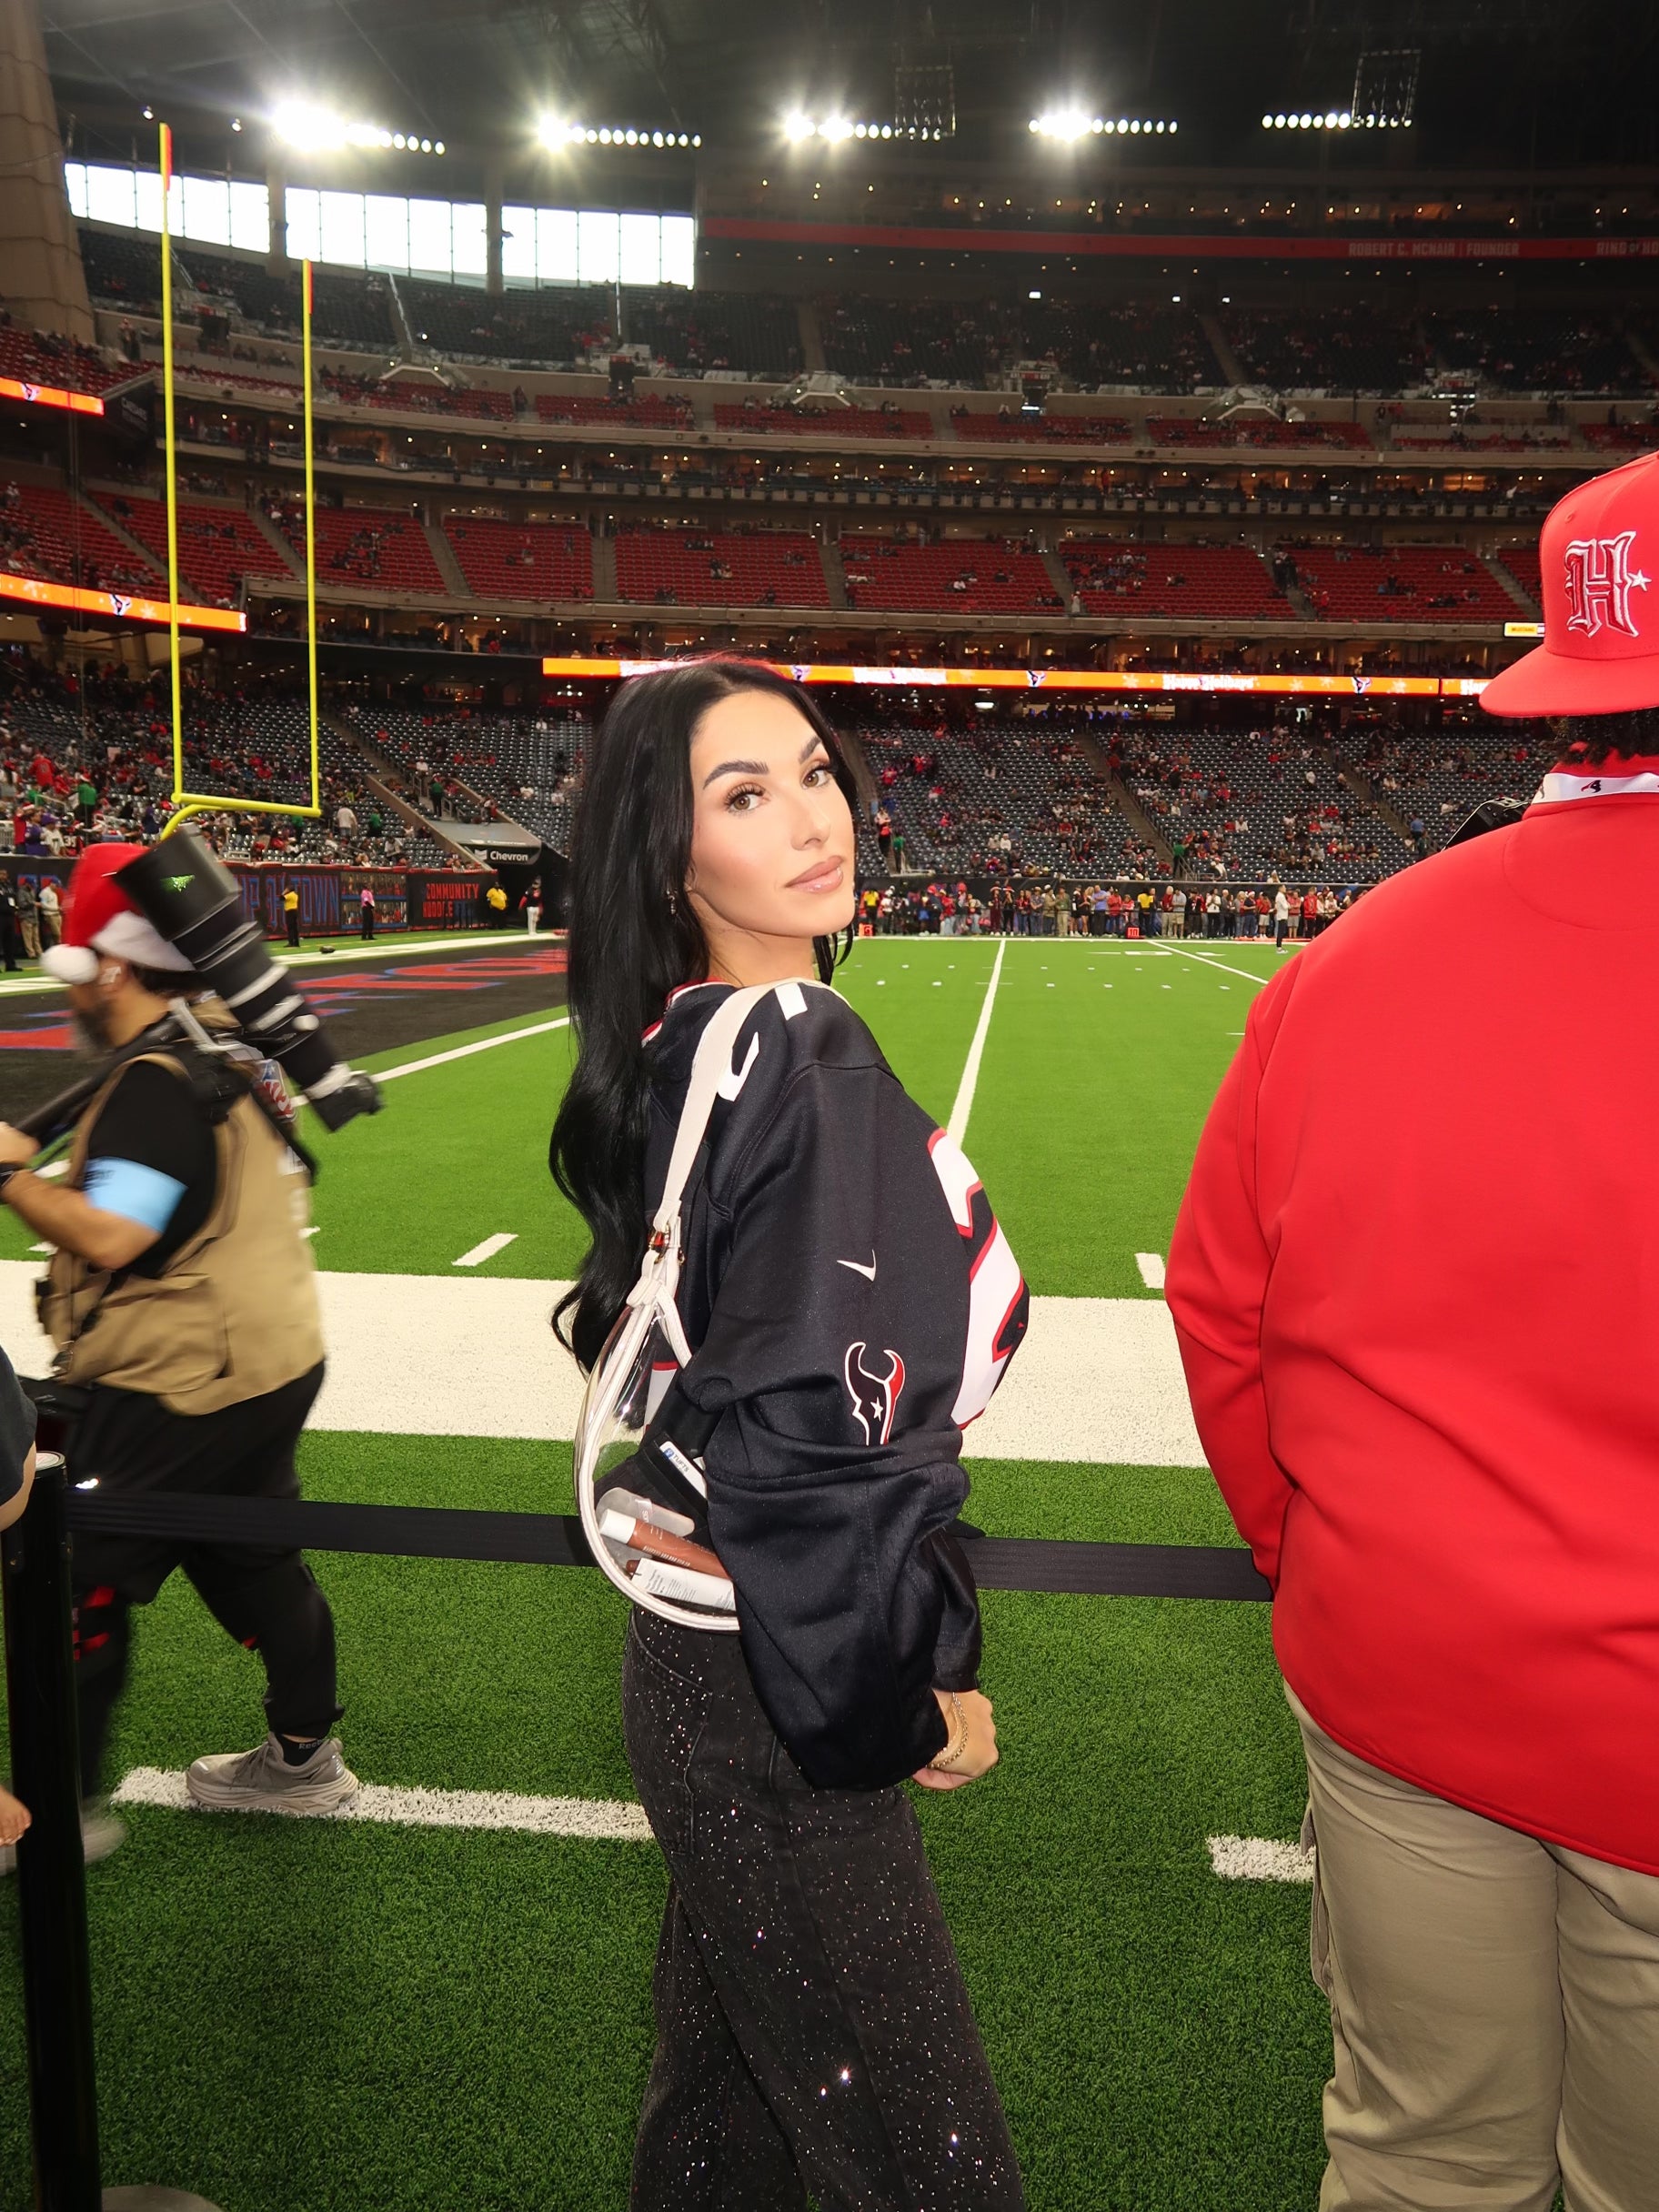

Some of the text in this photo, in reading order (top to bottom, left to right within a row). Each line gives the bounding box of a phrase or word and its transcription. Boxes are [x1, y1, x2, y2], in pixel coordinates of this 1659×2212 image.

[1349, 243, 1393, 256] ROBERT
[1397, 243, 1409, 256] C.
[1466, 243, 1520, 256] FOUNDER
[1596, 242, 1627, 256] RING
[1563, 530, 1639, 638] H
[489, 850, 528, 861] Chevron
[426, 883, 479, 900] COMMUNITY
[673, 1454, 689, 1473] TUFTS
